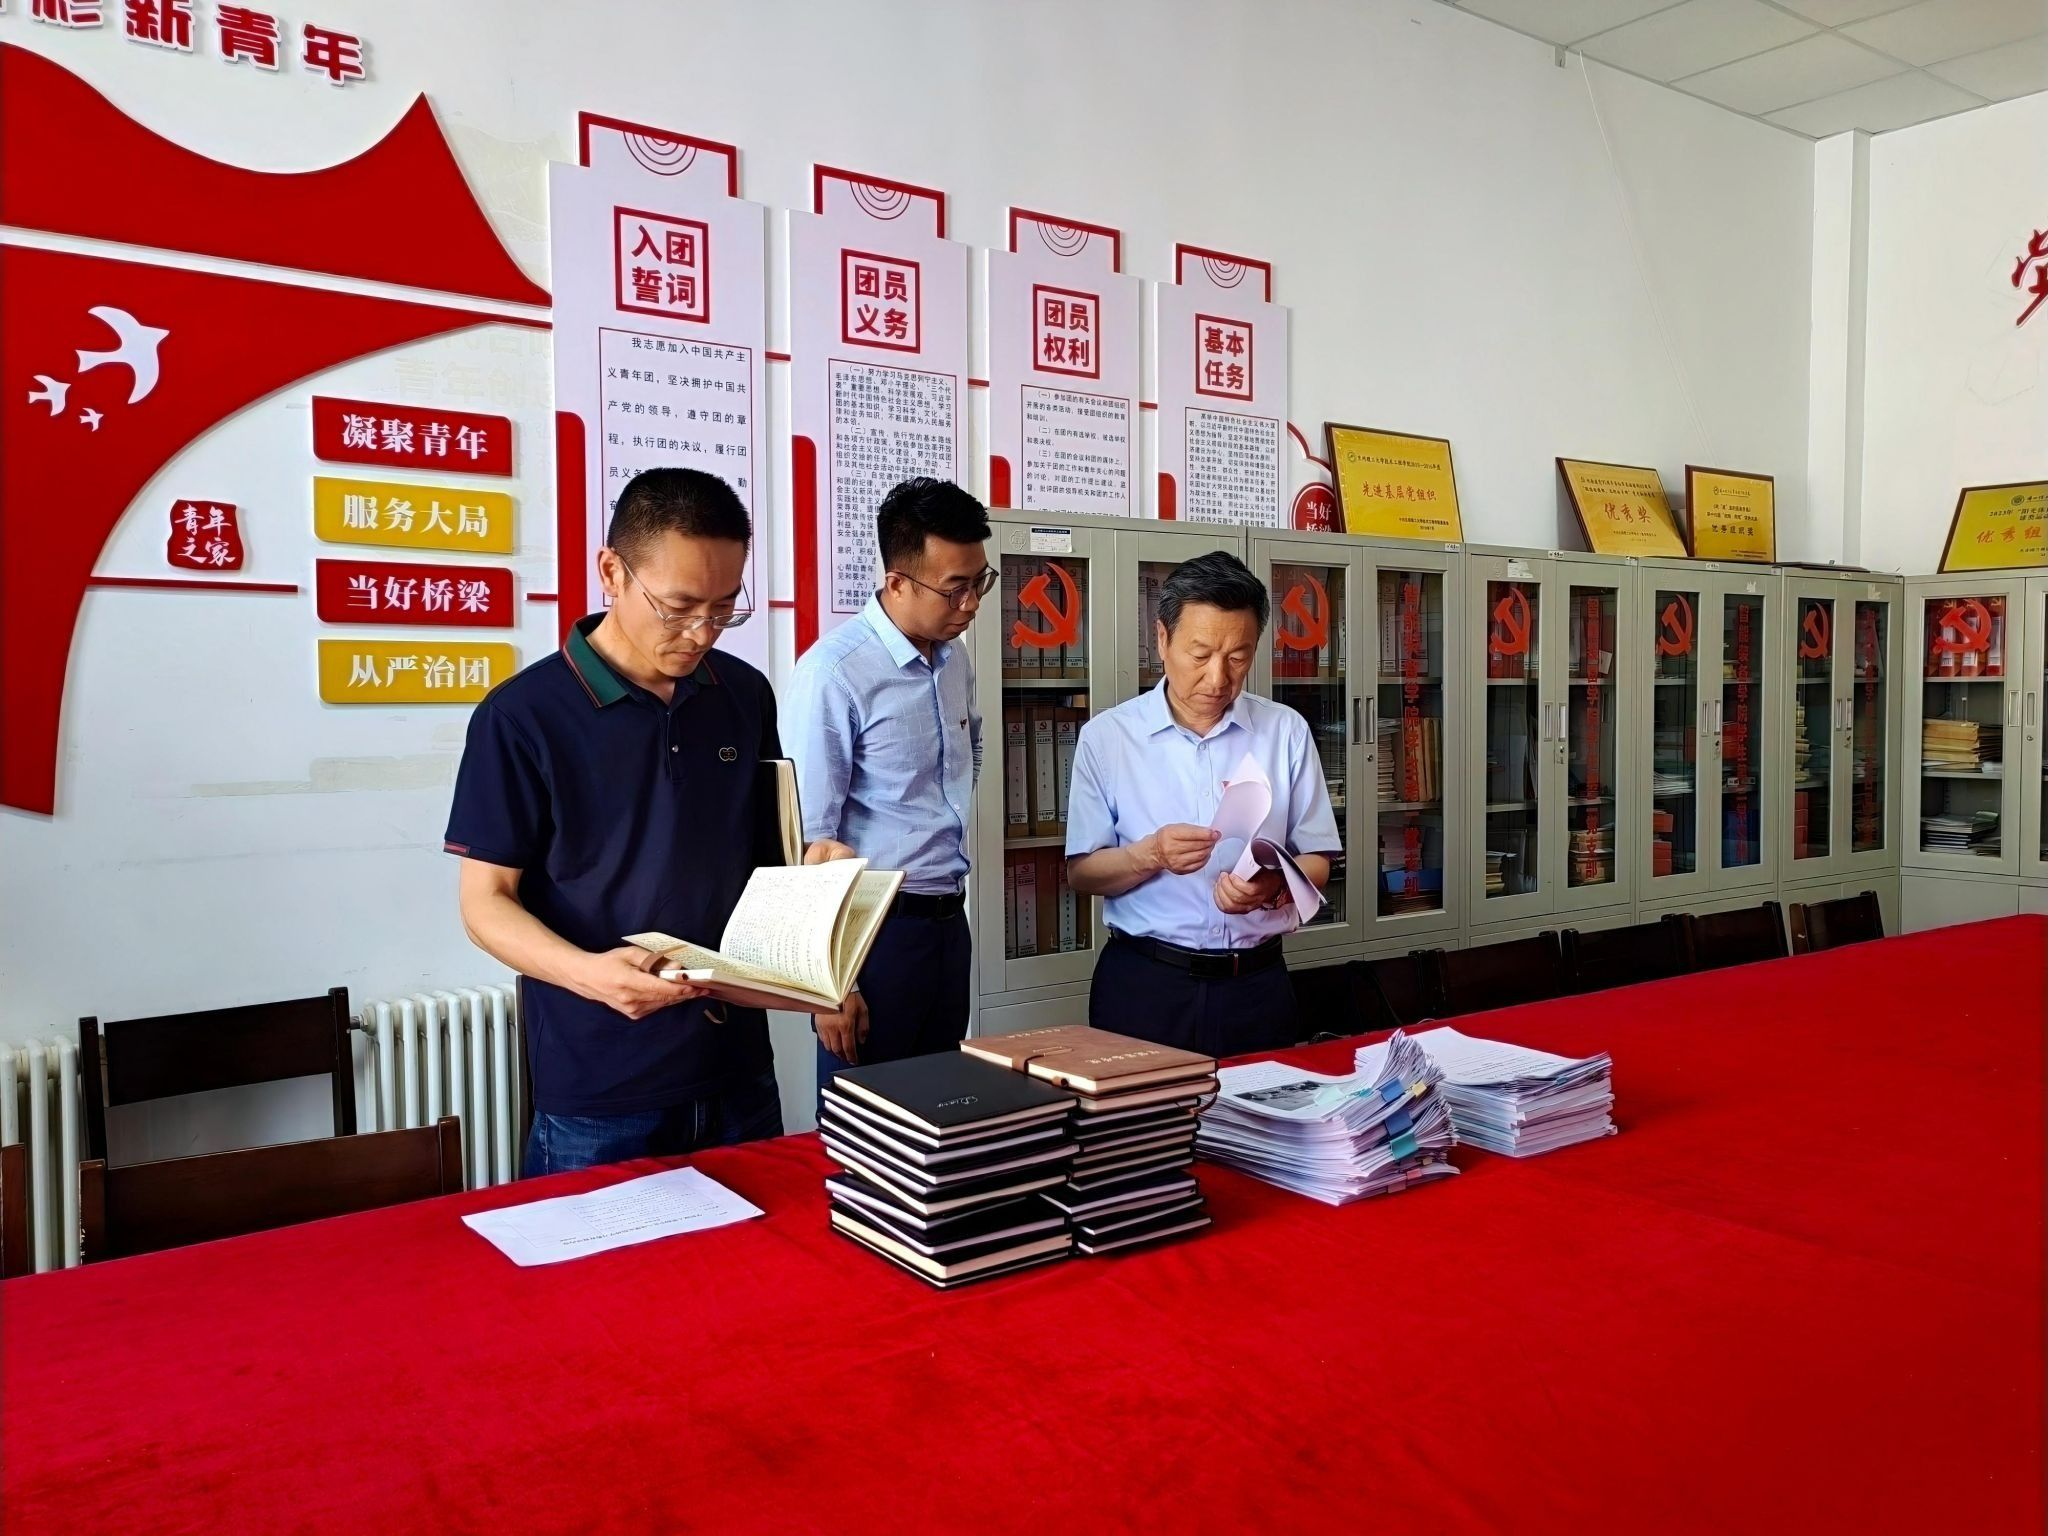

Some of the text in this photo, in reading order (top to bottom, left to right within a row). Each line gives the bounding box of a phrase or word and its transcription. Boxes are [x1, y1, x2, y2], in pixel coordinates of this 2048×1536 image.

[632, 225, 695, 267] 入团
[632, 267, 696, 309] 誓词
[855, 264, 908, 303] 团员
[855, 303, 909, 340] 义务
[1044, 298, 1090, 333] 团员
[632, 337, 746, 362] 我志愿加入中国共产主
[1044, 333, 1090, 367] 权利
[1204, 326, 1245, 357] 基本
[607, 368, 747, 394] 义青年团，坚决拥护中国共
[1204, 359, 1245, 390] 任务
[607, 400, 747, 425] 产党的领导，遵守团的章
[342, 413, 488, 460] 凝聚青年
[608, 433, 747, 456] 程，执行团的决议，履行团
[737, 477, 748, 488] 勤
[1362, 480, 1437, 502] 先进基层党组织
[175, 503, 232, 536] 青年
[343, 493, 488, 538] 服务大局
[1306, 501, 1332, 521] 当好
[1604, 502, 1653, 524] 优秀奖
[837, 529, 876, 538] 安全挺身而
[1976, 526, 2042, 544] 优秀组
[177, 536, 236, 567] 之家
[837, 546, 876, 556] 意识，积极
[347, 575, 490, 614] 当好桥梁
[346, 654, 490, 689] 从严治团
